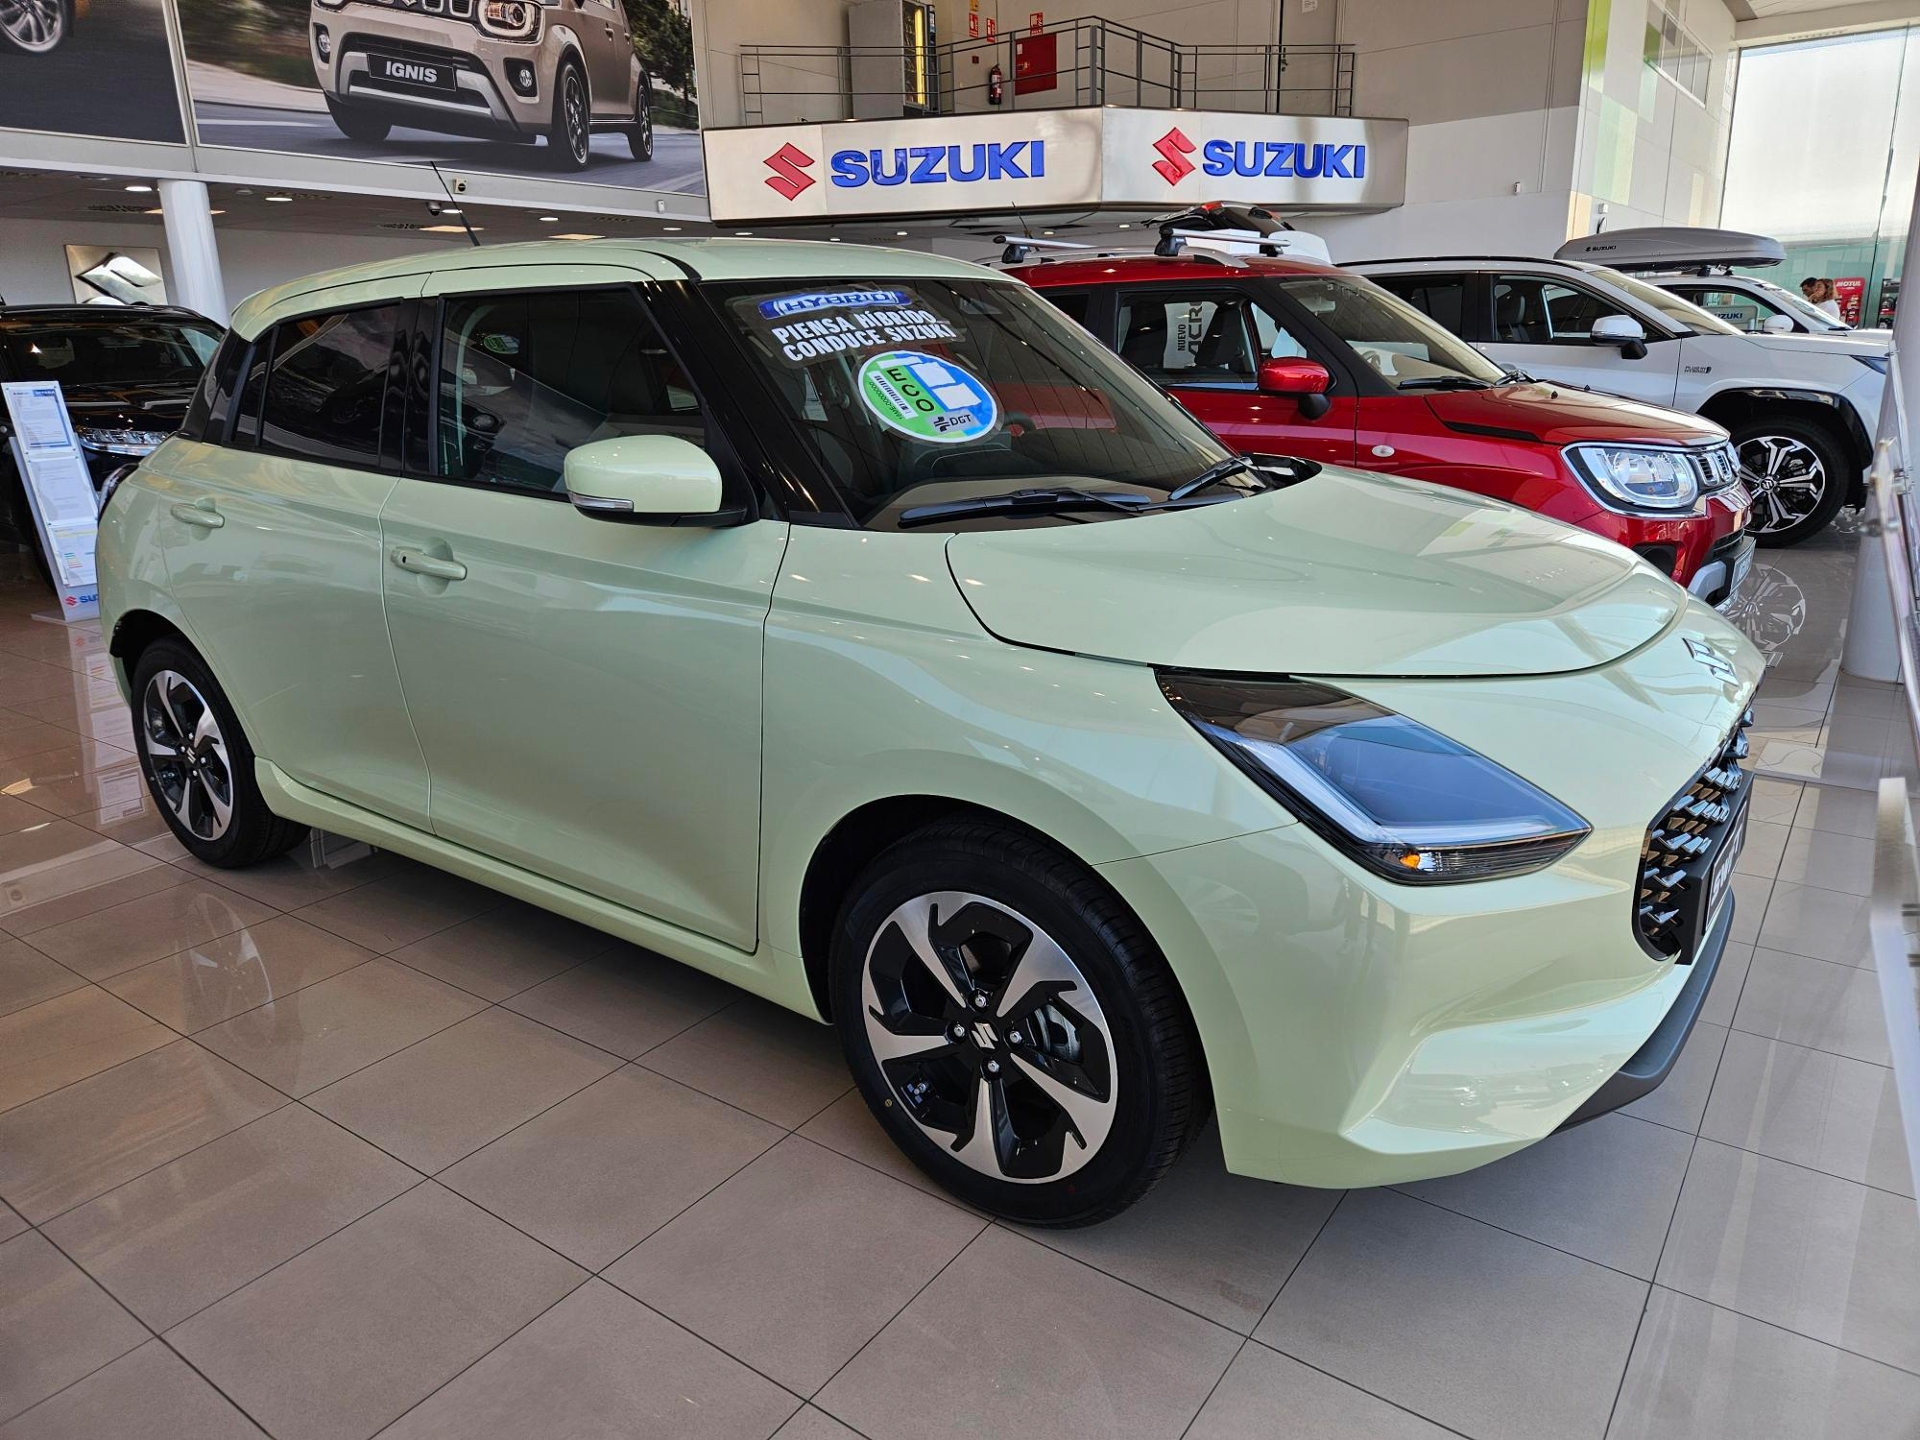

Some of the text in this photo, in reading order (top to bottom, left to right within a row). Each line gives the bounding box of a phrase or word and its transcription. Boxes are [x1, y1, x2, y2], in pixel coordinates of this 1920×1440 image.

[385, 60, 438, 83] IGNIS
[830, 139, 1046, 189] SUZUKI
[1202, 138, 1366, 180] SUZUKI
[784, 290, 891, 312] HYBRID
[771, 309, 937, 345] PIENSA HÍBRIDO
[782, 323, 957, 362] CONDUCE SUZUKI
[1177, 323, 1187, 352] NUEVO
[886, 368, 935, 412] ECO
[948, 414, 972, 427] DGT
